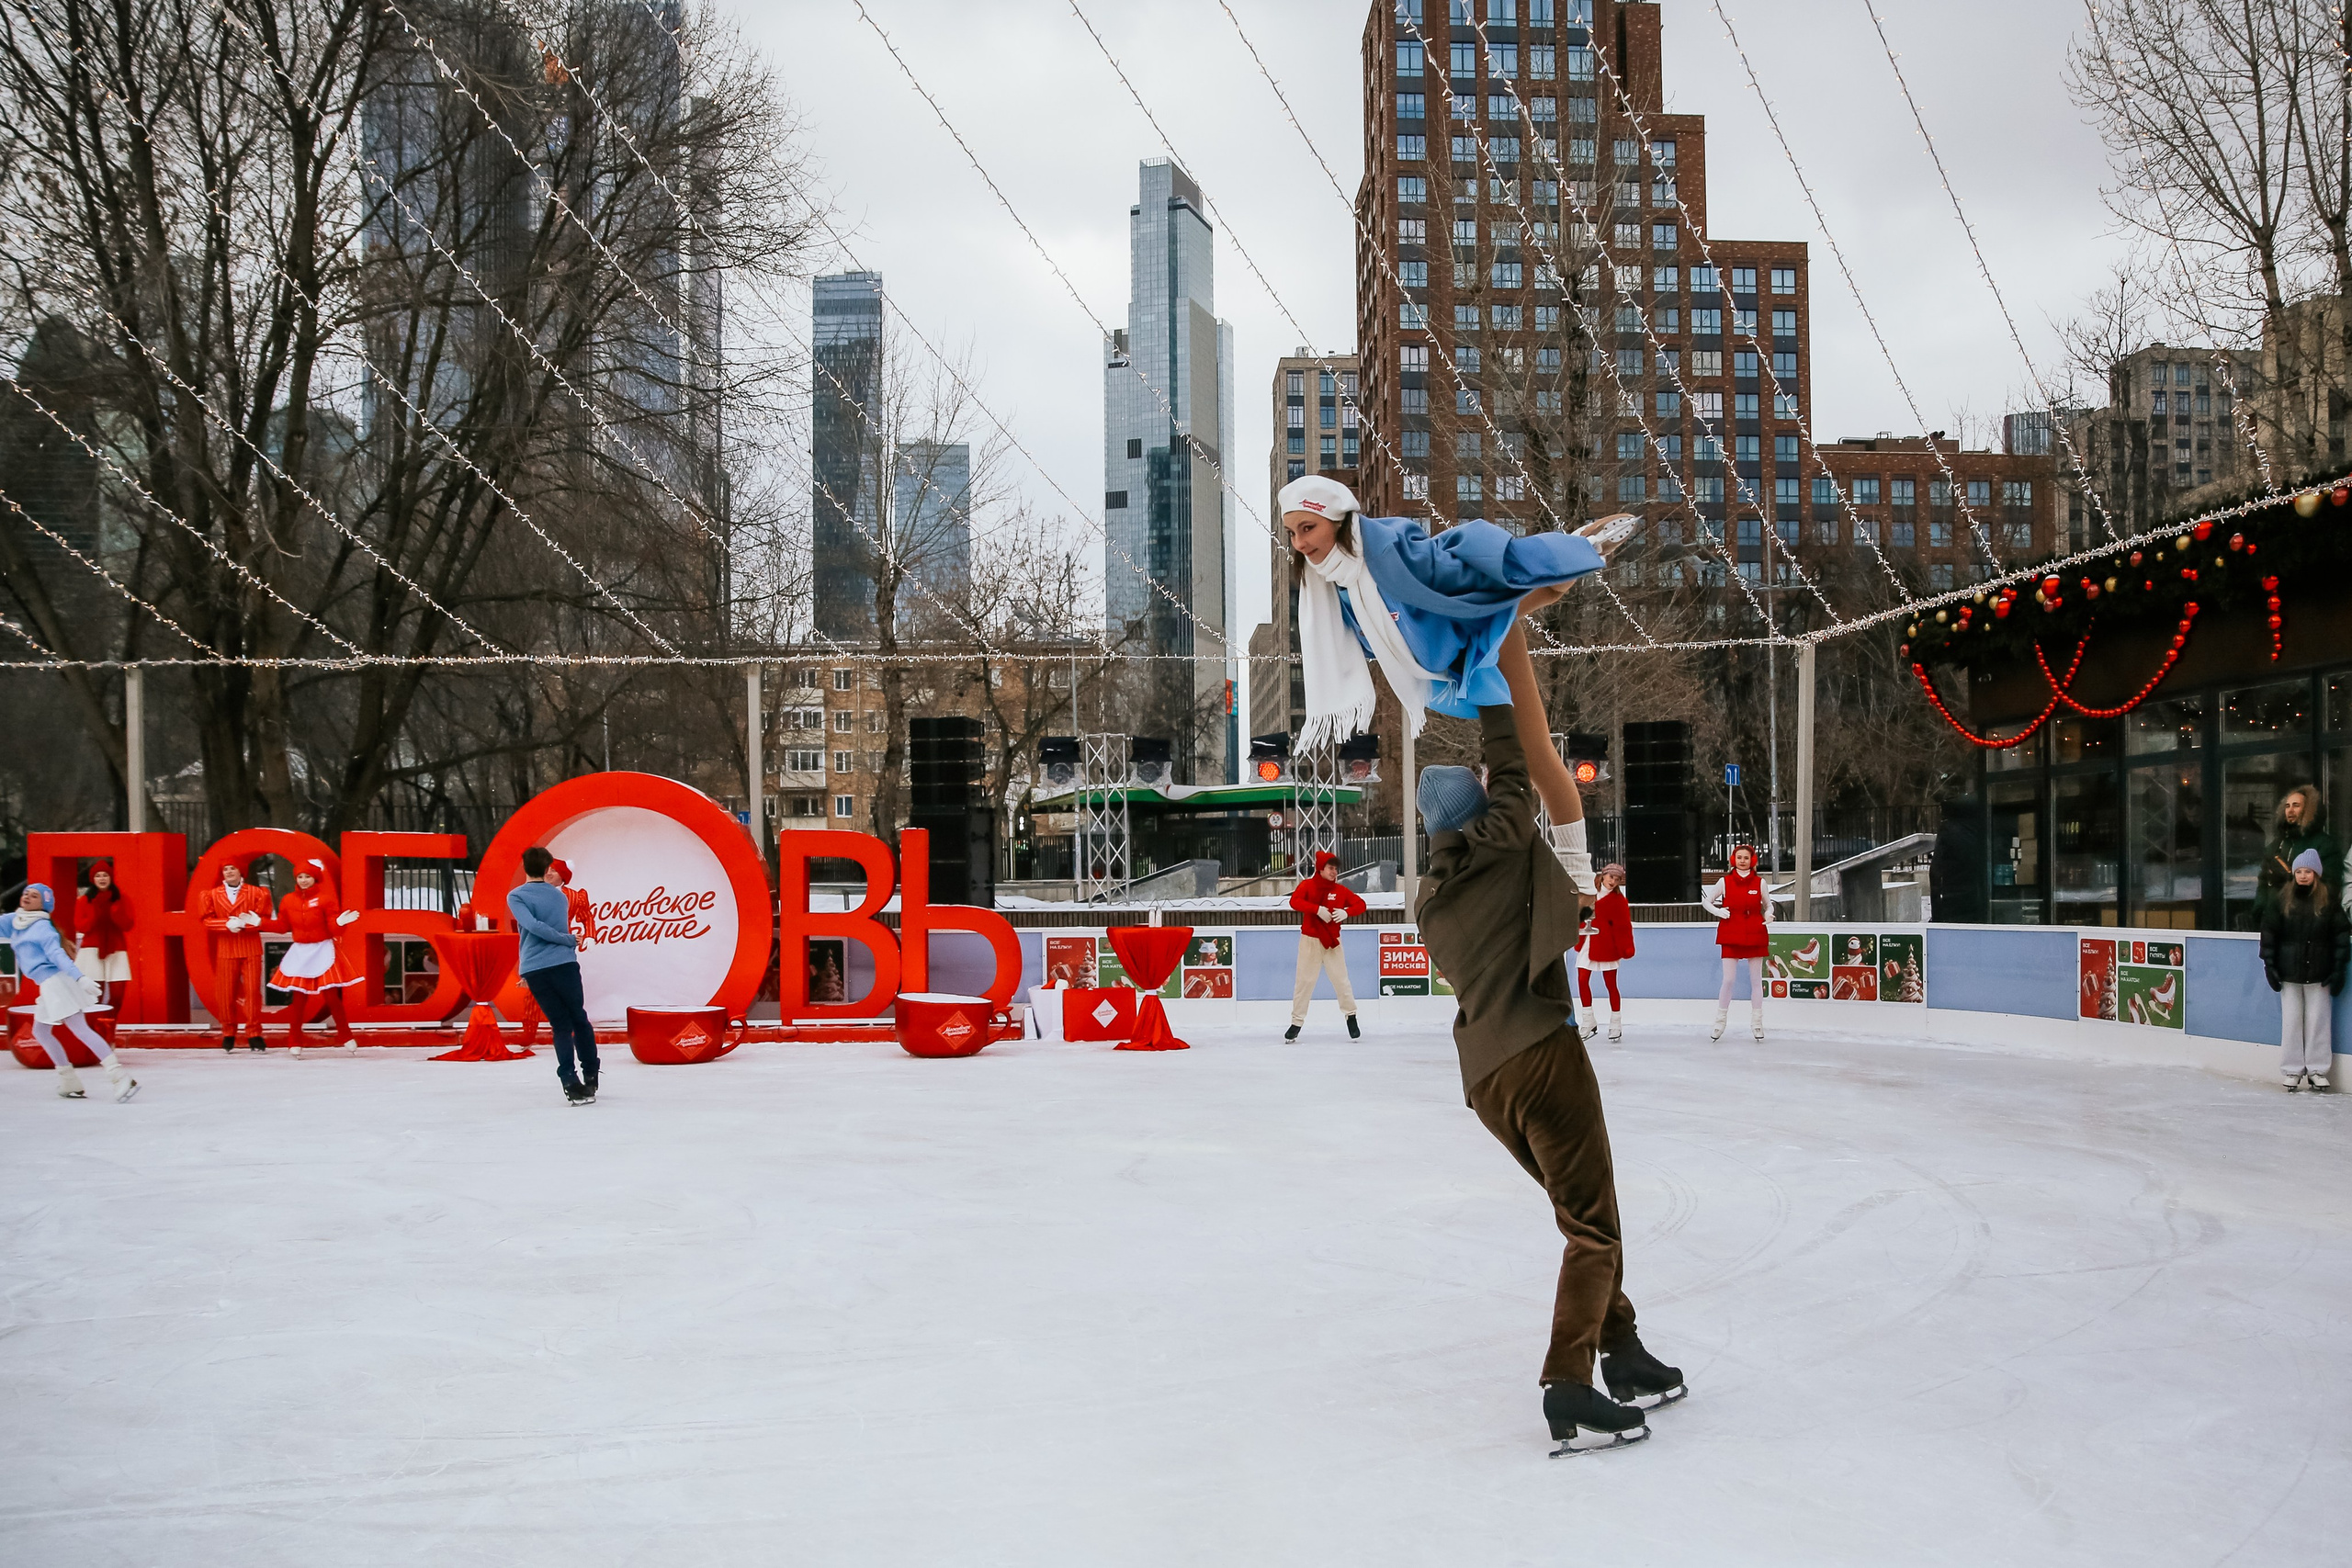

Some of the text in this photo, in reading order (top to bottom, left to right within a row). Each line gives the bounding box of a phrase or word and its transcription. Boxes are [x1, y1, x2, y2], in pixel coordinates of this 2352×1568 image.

[9, 770, 1023, 1026] ЛЮБОВЬ
[589, 886, 716, 921] осковское
[1384, 952, 1426, 962] ЗИМА
